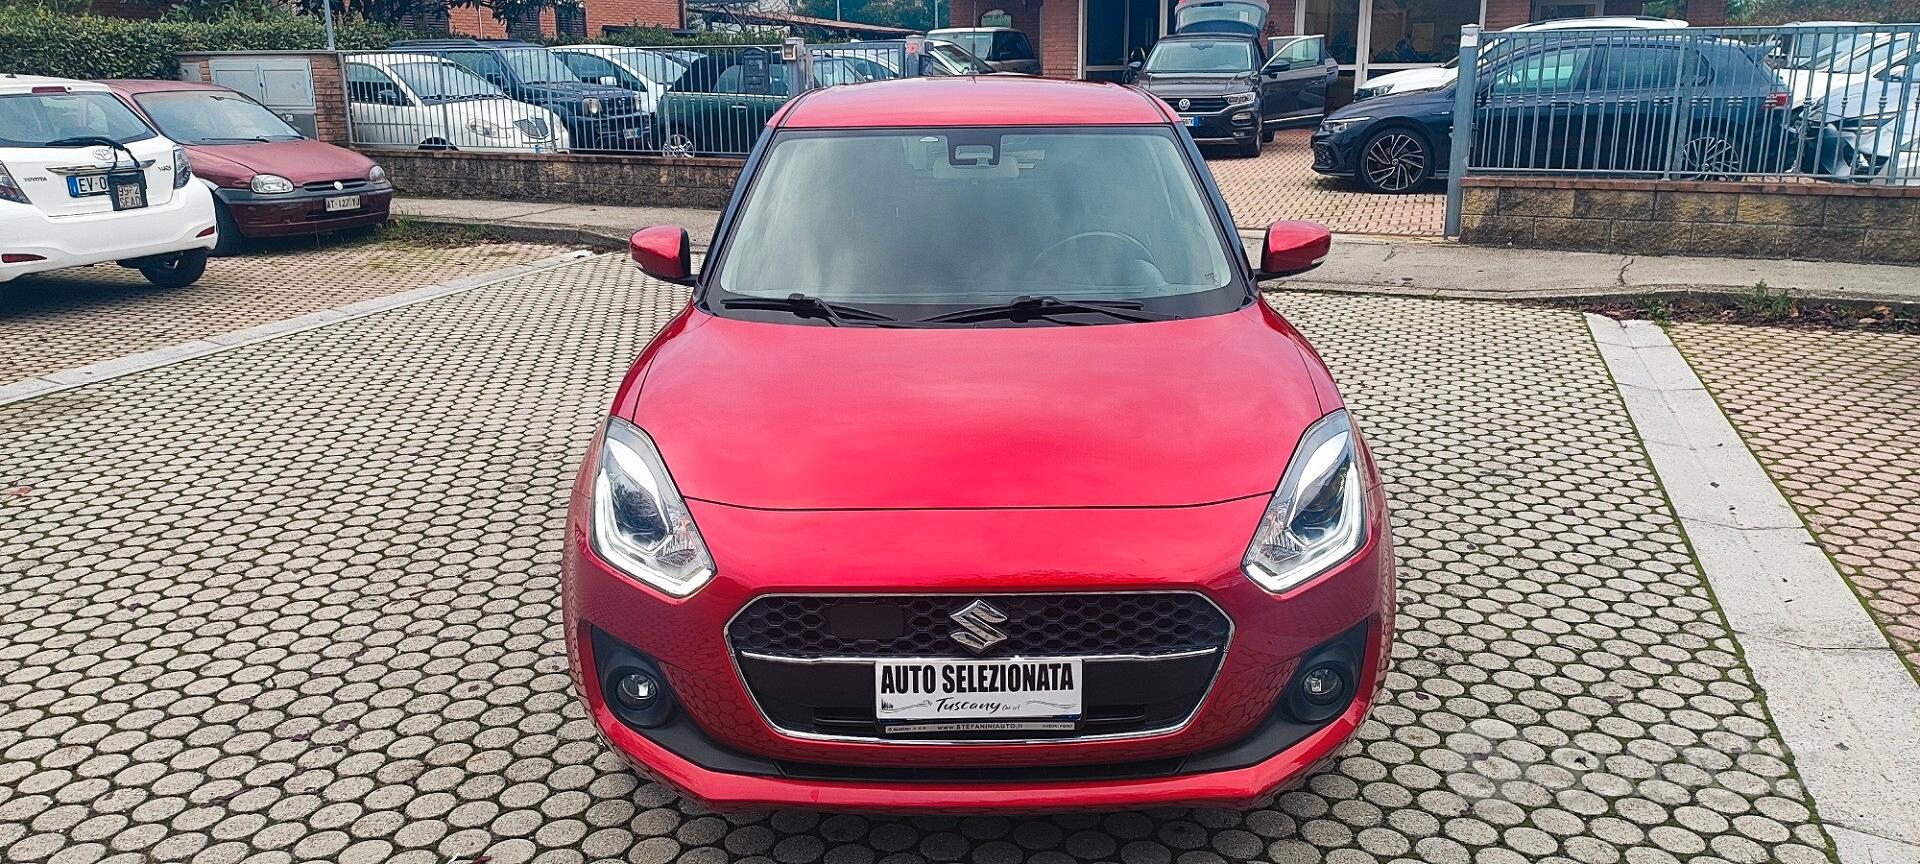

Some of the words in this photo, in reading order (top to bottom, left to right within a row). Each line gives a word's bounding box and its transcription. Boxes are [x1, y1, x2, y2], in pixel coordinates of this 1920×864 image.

[881, 665, 936, 694] AUTO
[942, 663, 1074, 693] SELEZIONATA
[936, 697, 1001, 714] Tuscany
